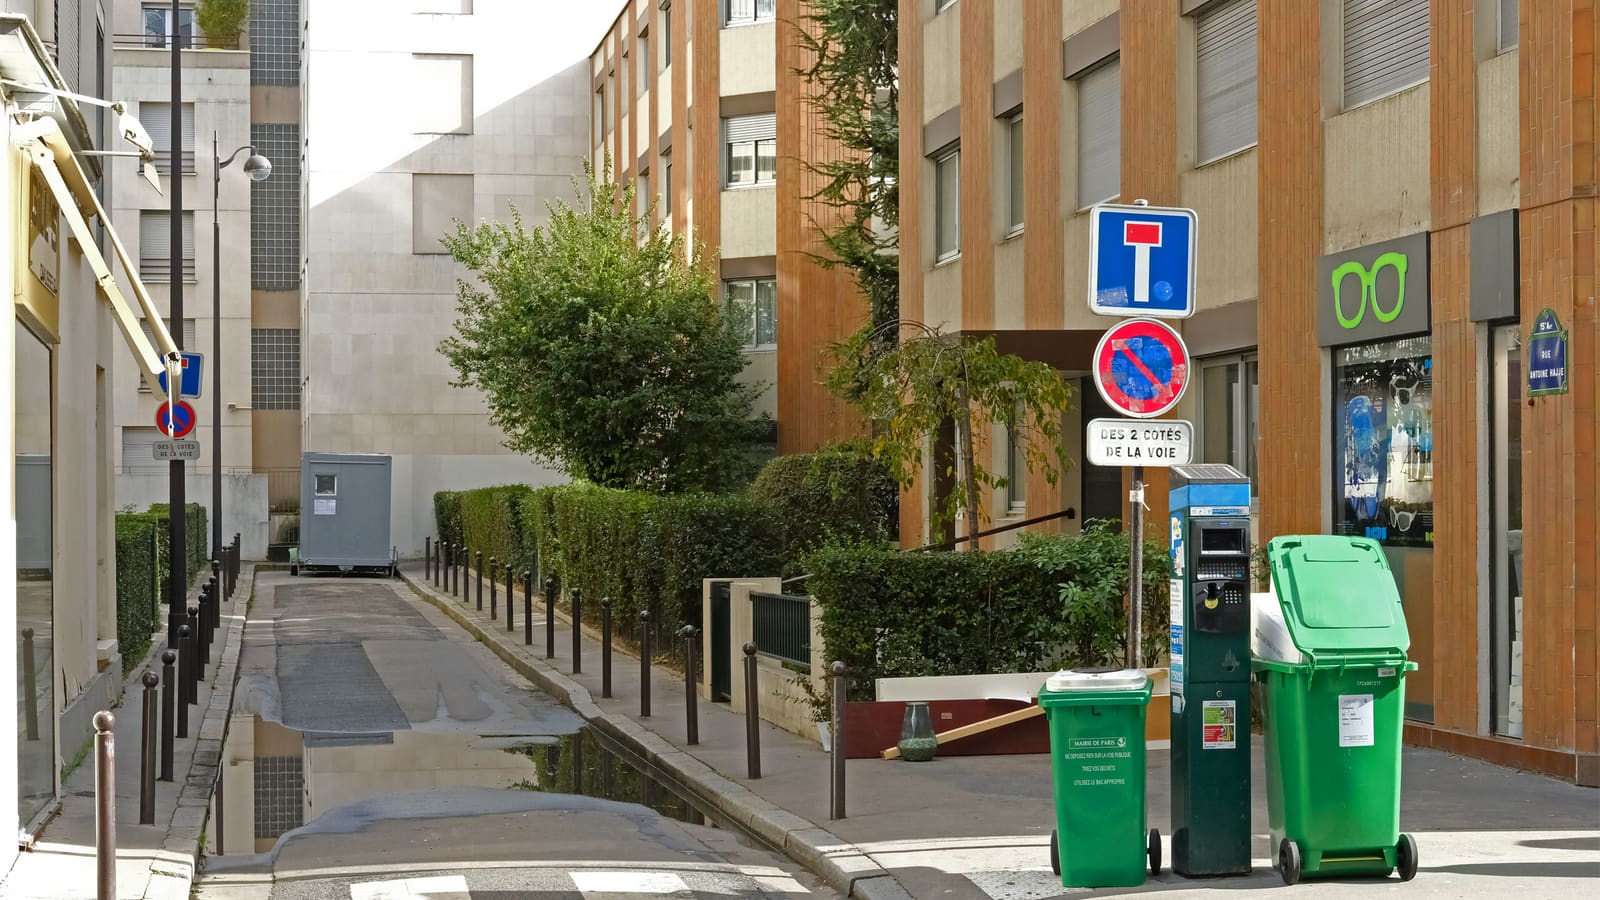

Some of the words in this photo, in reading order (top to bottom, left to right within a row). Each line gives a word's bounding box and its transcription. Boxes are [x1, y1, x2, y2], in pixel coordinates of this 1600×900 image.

[1541, 350, 1551, 359] RUE
[1530, 369, 1548, 379] ANTOINE
[1101, 429, 1125, 440] DES
[1130, 429, 1138, 440] 2
[1106, 447, 1122, 457] DE
[1127, 447, 1141, 457] LA
[1148, 447, 1176, 458] VOIE
